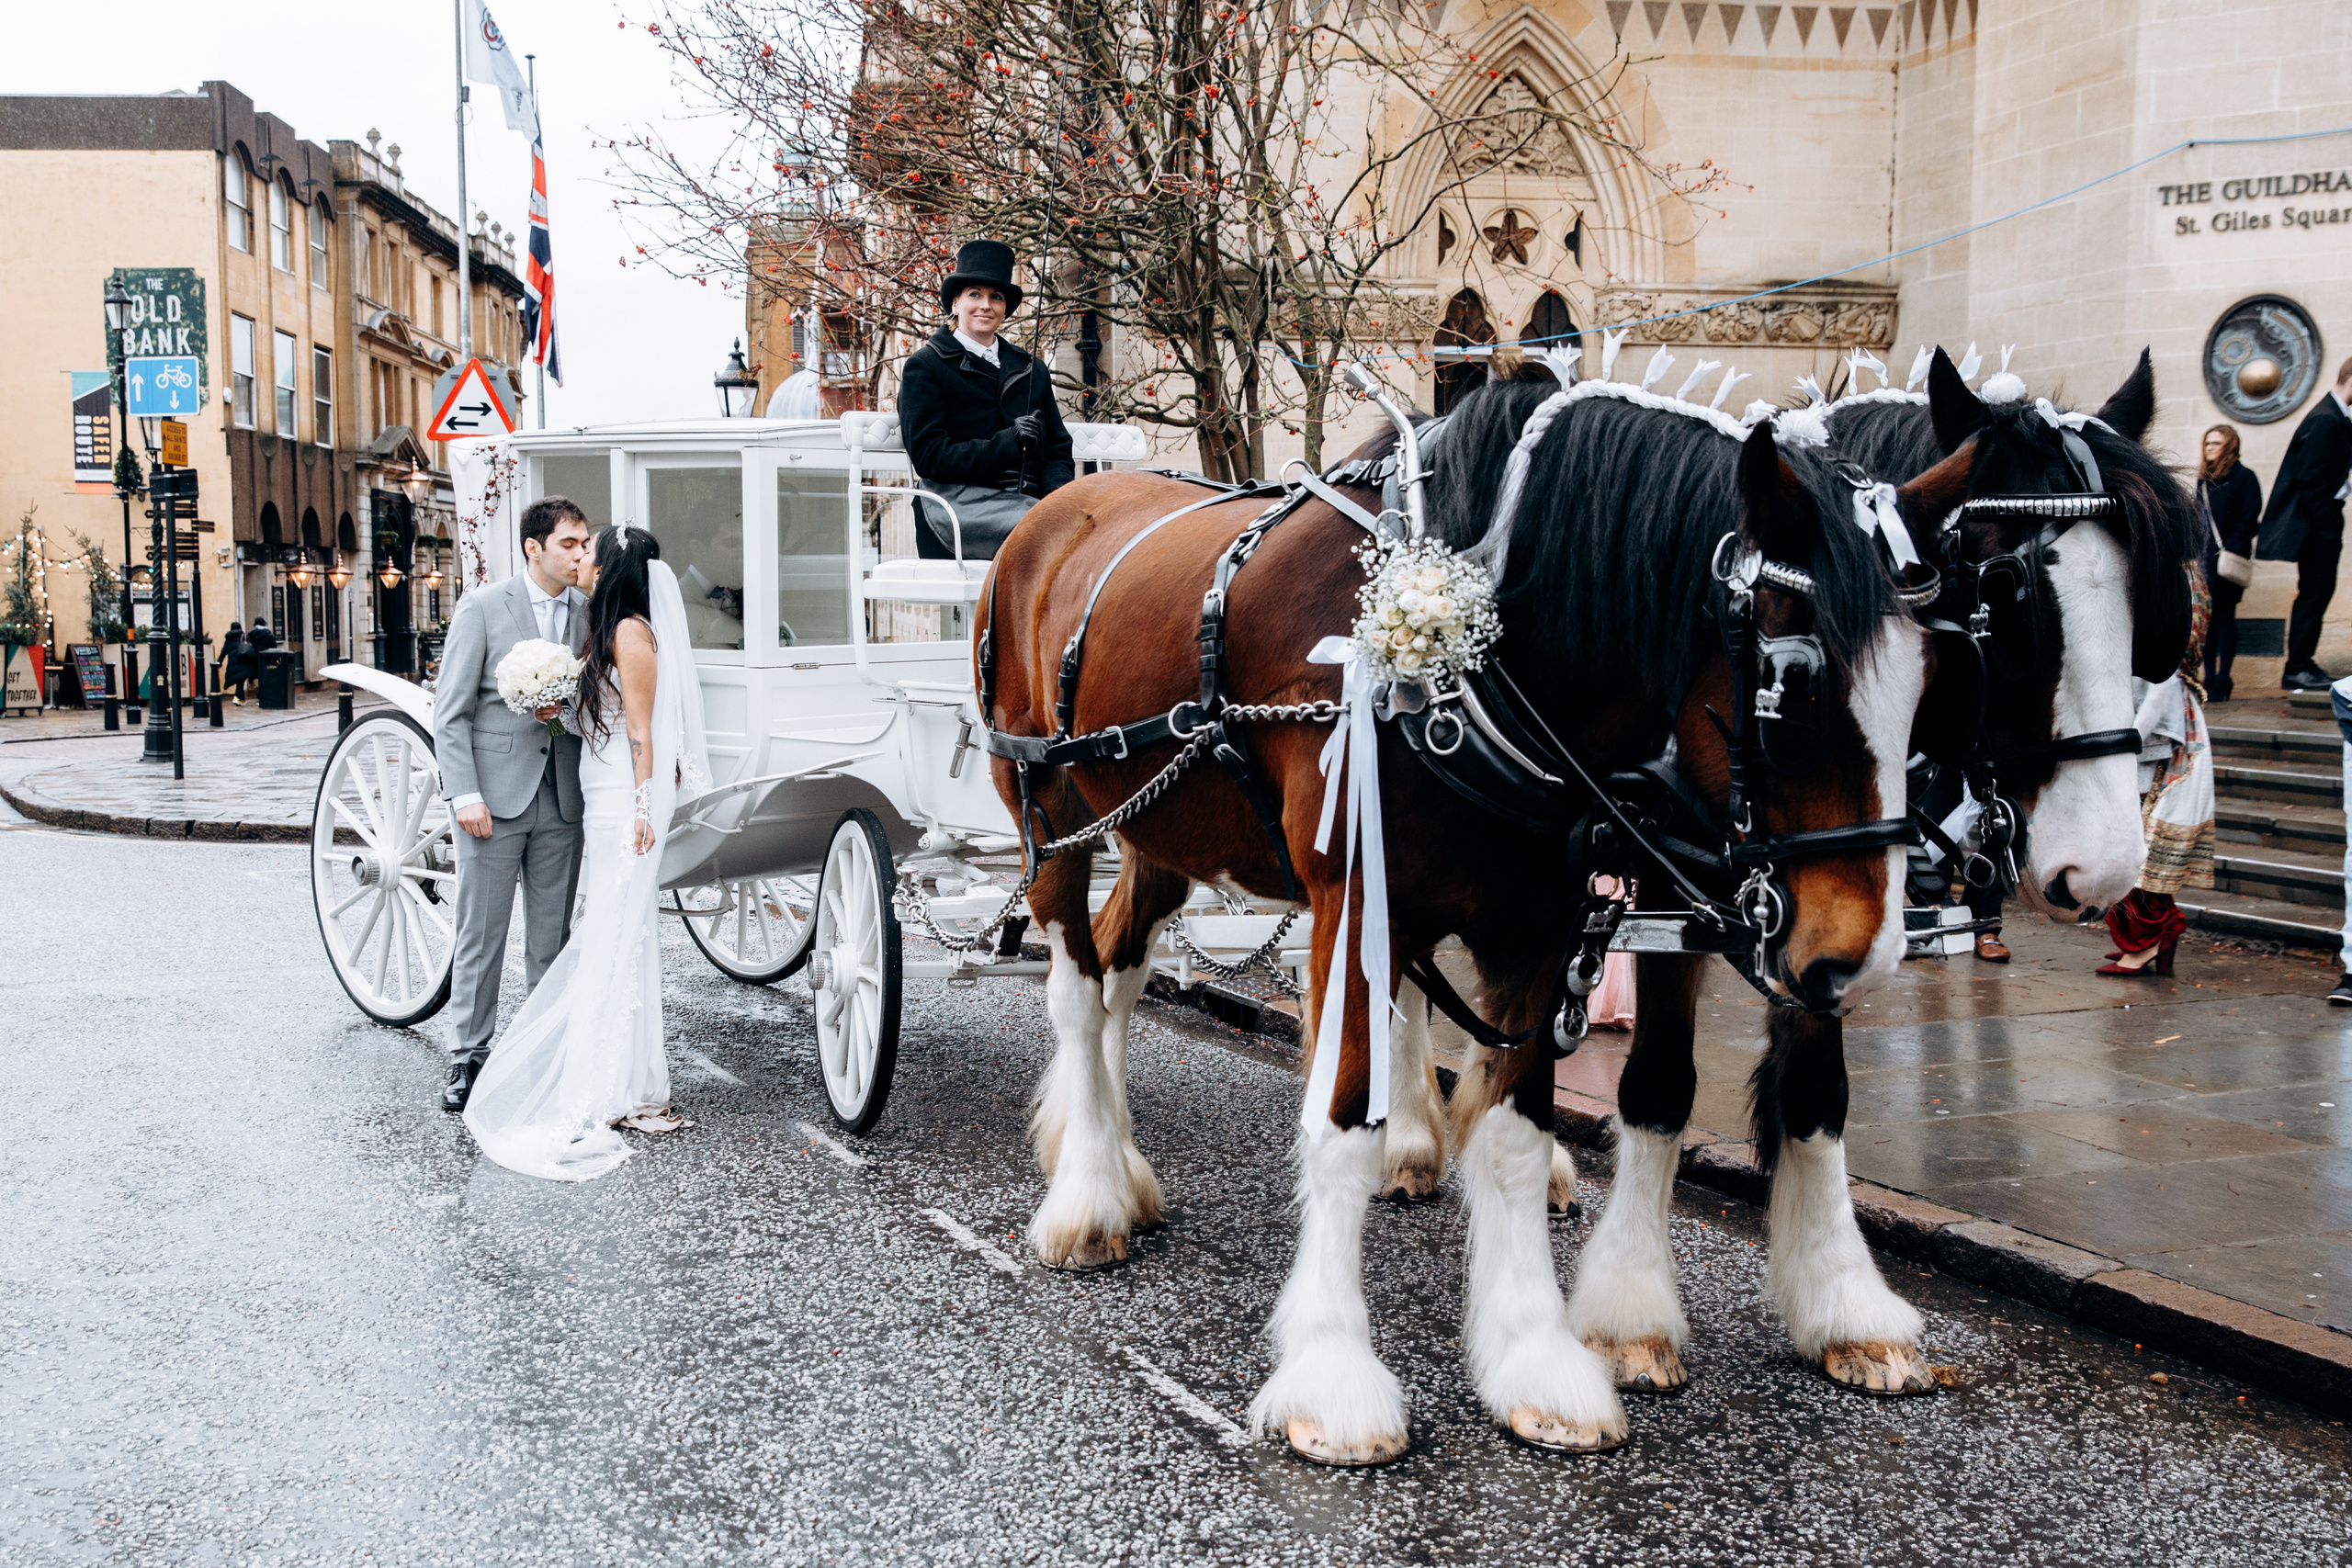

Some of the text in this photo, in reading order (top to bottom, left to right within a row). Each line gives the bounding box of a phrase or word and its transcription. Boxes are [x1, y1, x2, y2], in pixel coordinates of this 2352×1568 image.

[2158, 170, 2352, 205] THE GUILDHA
[2176, 206, 2352, 235] St. Giles Squar
[145, 277, 164, 290] THE
[130, 294, 181, 322] OLD
[122, 328, 192, 355] BANK
[74, 414, 93, 463] ROUTE
[92, 415, 110, 463] SAFER
[7, 671, 20, 684] GET
[7, 689, 37, 702] TOGETHER
